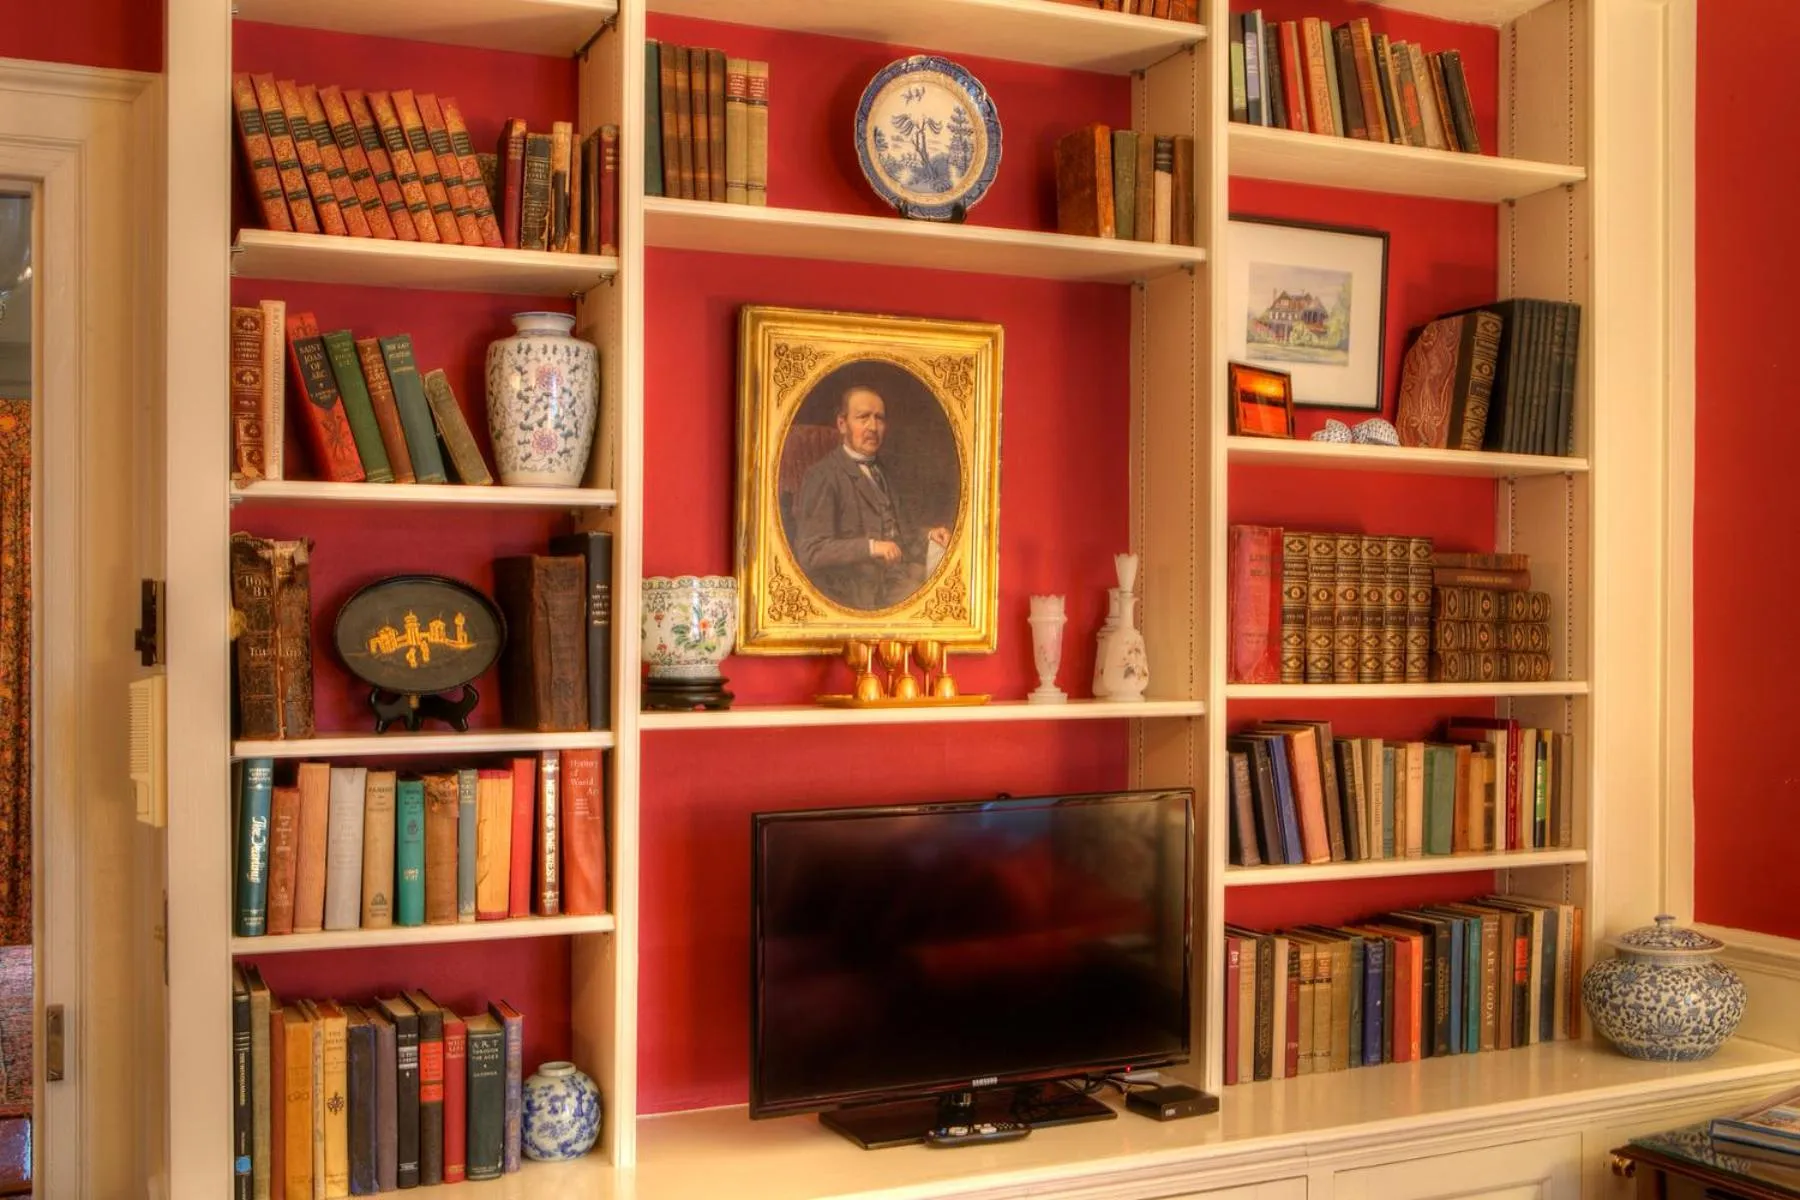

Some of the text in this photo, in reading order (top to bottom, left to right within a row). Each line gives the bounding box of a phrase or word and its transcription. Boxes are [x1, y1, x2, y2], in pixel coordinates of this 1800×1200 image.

[300, 343, 320, 354] SAINT
[304, 352, 322, 366] JOAN
[310, 361, 321, 371] OF
[311, 369, 327, 380] ARC
[570, 777, 594, 786] World
[1486, 949, 1495, 1026] ART TODAY
[472, 1039, 499, 1049] ART
[972, 1076, 998, 1087] SAMSUNG
